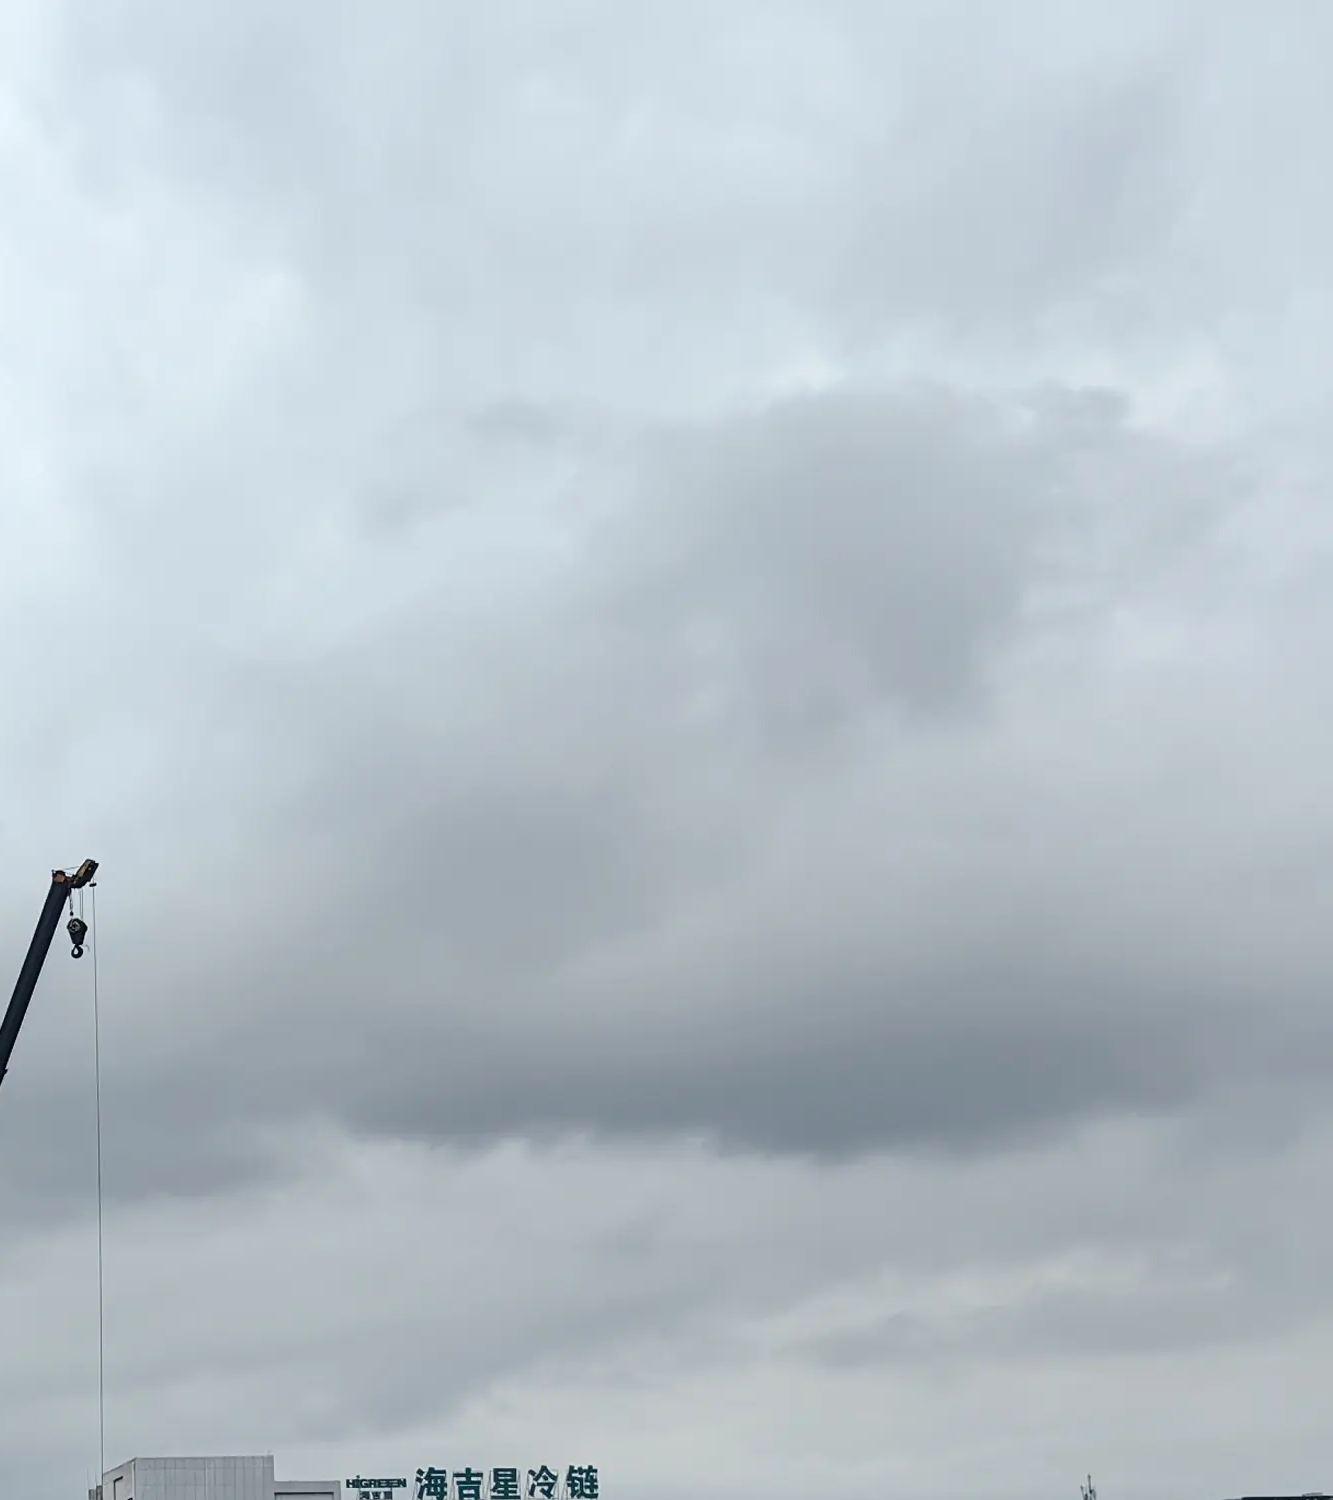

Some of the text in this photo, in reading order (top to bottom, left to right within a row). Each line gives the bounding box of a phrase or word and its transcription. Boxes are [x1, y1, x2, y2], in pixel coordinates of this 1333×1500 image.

[415, 1465, 599, 1500] 海吉星冷链
